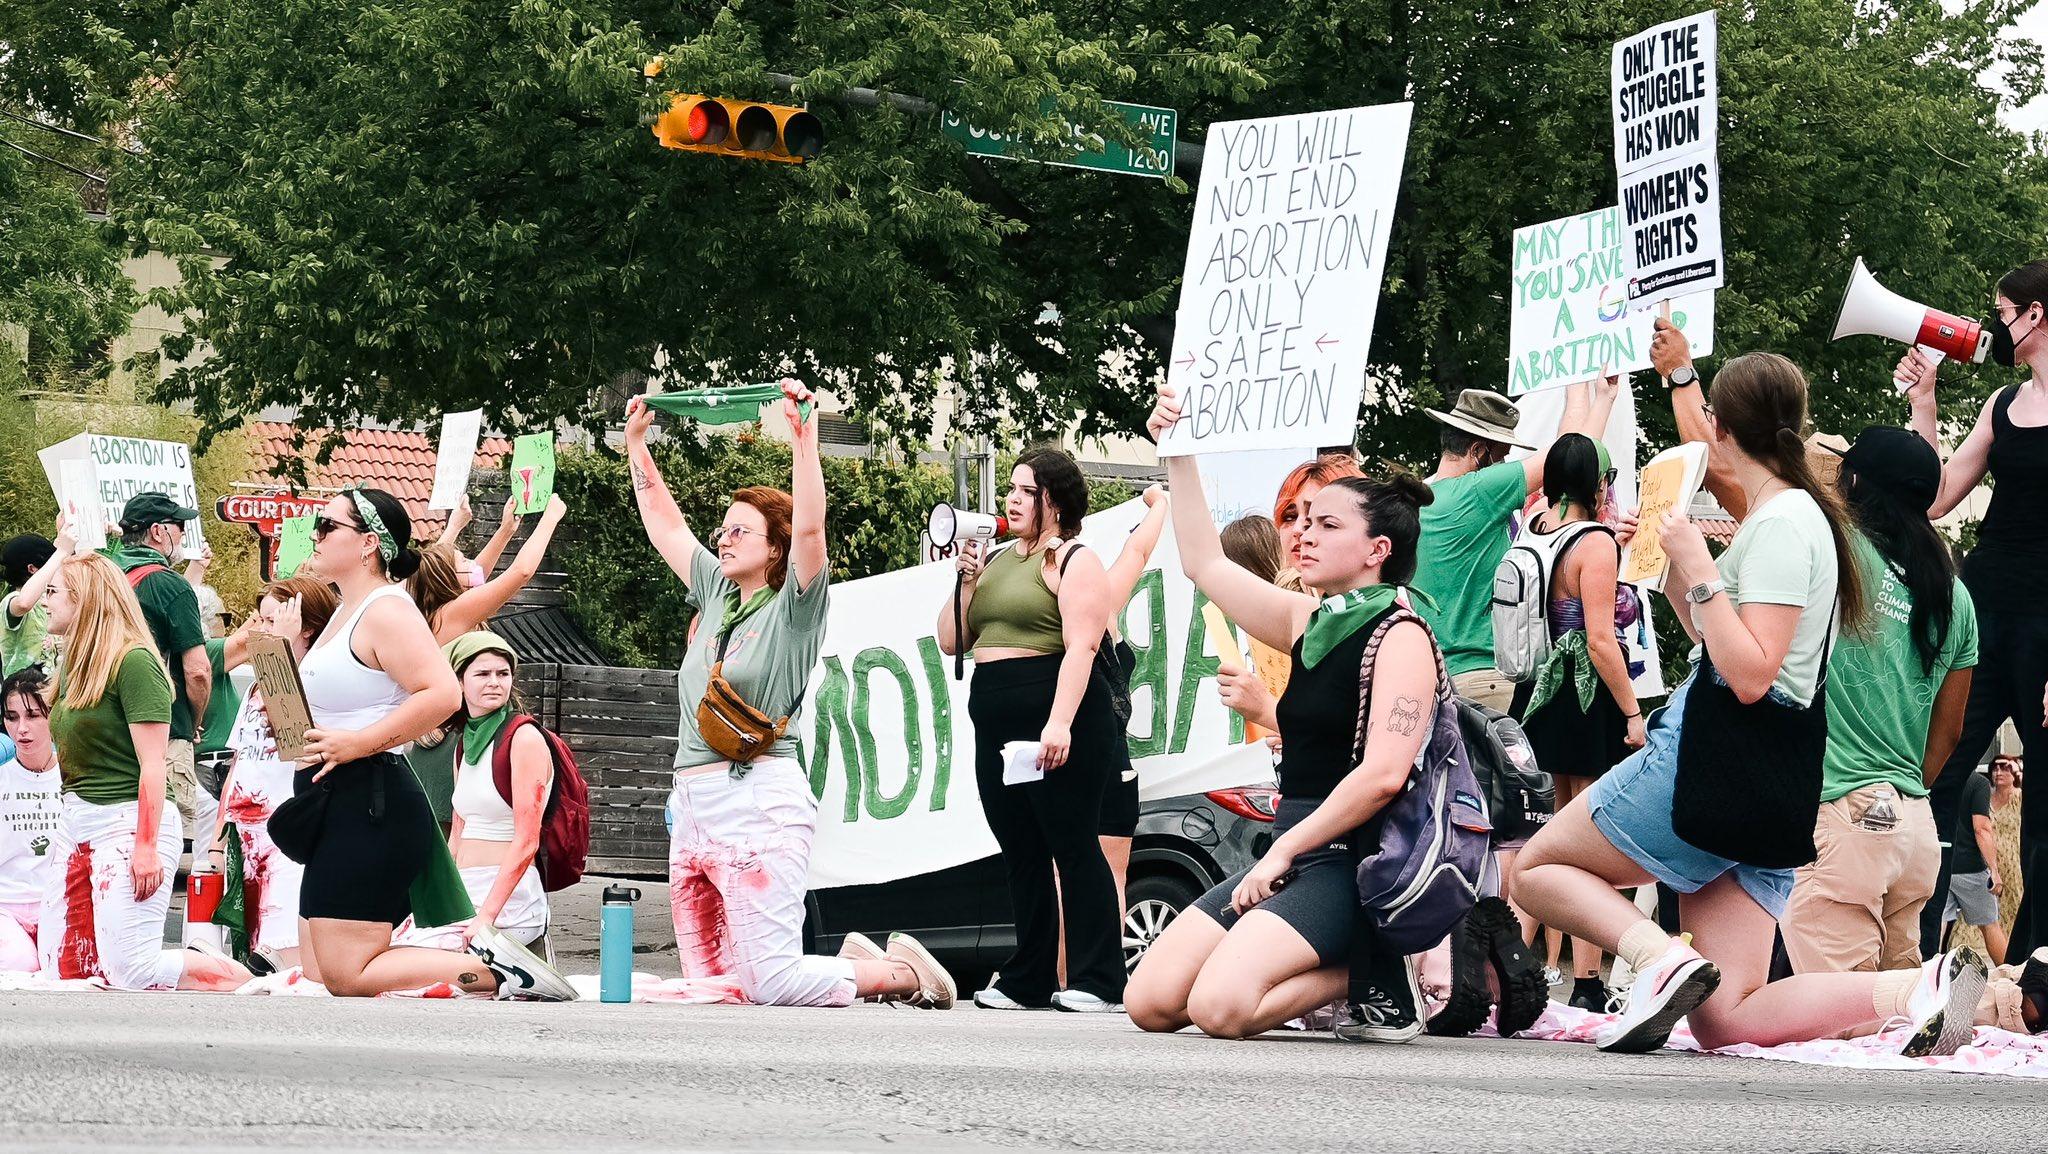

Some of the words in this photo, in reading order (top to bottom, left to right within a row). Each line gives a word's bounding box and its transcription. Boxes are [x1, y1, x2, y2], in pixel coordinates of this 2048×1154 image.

[1623, 35, 1657, 82] ONLY
[1661, 23, 1699, 67] THE
[1620, 61, 1705, 122] STRUGGLE
[1139, 112, 1170, 136] AVE
[1222, 123, 1278, 178] YOU
[1298, 114, 1361, 164] WILL
[1625, 119, 1652, 163] HAS
[1655, 105, 1700, 151] WON
[1210, 173, 1277, 224] NOT
[1287, 163, 1356, 214] END
[1624, 163, 1708, 226] WOMEN'S
[1200, 209, 1378, 285] ABORTION
[1514, 219, 1569, 270] MAY
[1580, 207, 1623, 252] TH
[1635, 213, 1698, 269] RIGHTS
[1209, 274, 1314, 336] ONLY
[1514, 265, 1562, 308] YOU
[1553, 297, 1575, 338] A
[1200, 326, 1302, 379] SAFE
[1510, 327, 1636, 394] ABORTION
[1169, 363, 1336, 440] ABORTION
[91, 437, 164, 466] ABORTION
[173, 445, 185, 468] IS
[184, 485, 194, 509] IS
[227, 499, 326, 519] COURTYAR
[1874, 602, 1910, 625] CHANG
[1881, 580, 1895, 592] TO
[16, 792, 50, 800] RISE
